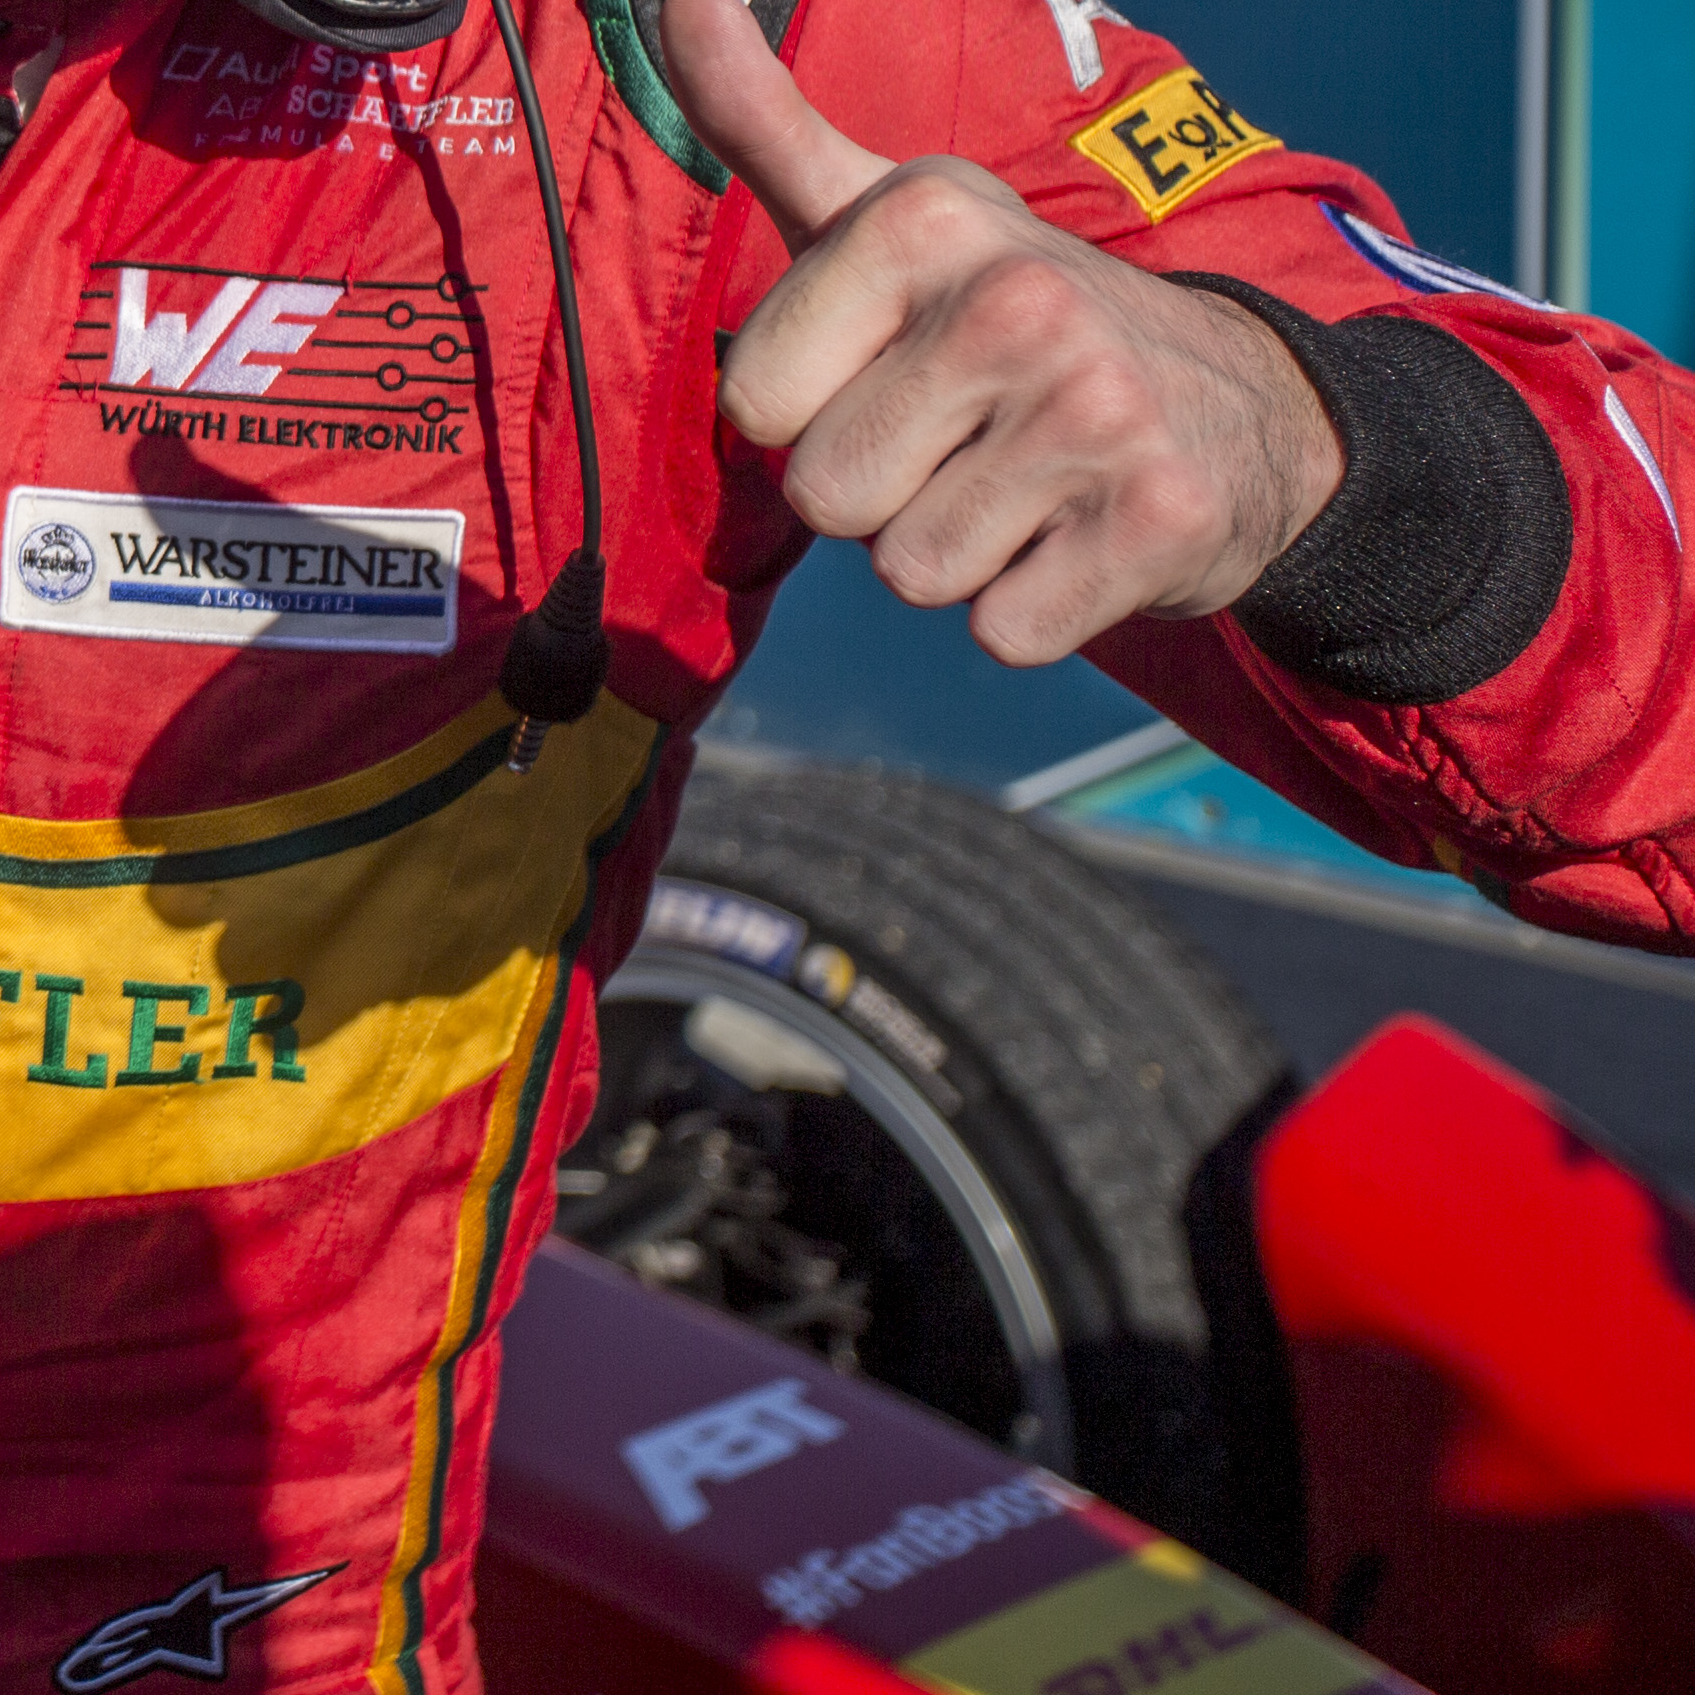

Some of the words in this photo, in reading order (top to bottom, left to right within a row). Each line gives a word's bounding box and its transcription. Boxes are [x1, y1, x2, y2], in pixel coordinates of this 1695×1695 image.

[416, 135, 516, 156] TEAM
[109, 266, 347, 396] WE
[99, 398, 228, 443] WÜRTH
[238, 414, 463, 455] ELEKTRONIK
[110, 531, 445, 591] WARSTEINER
[622, 1376, 850, 1533] ABT
